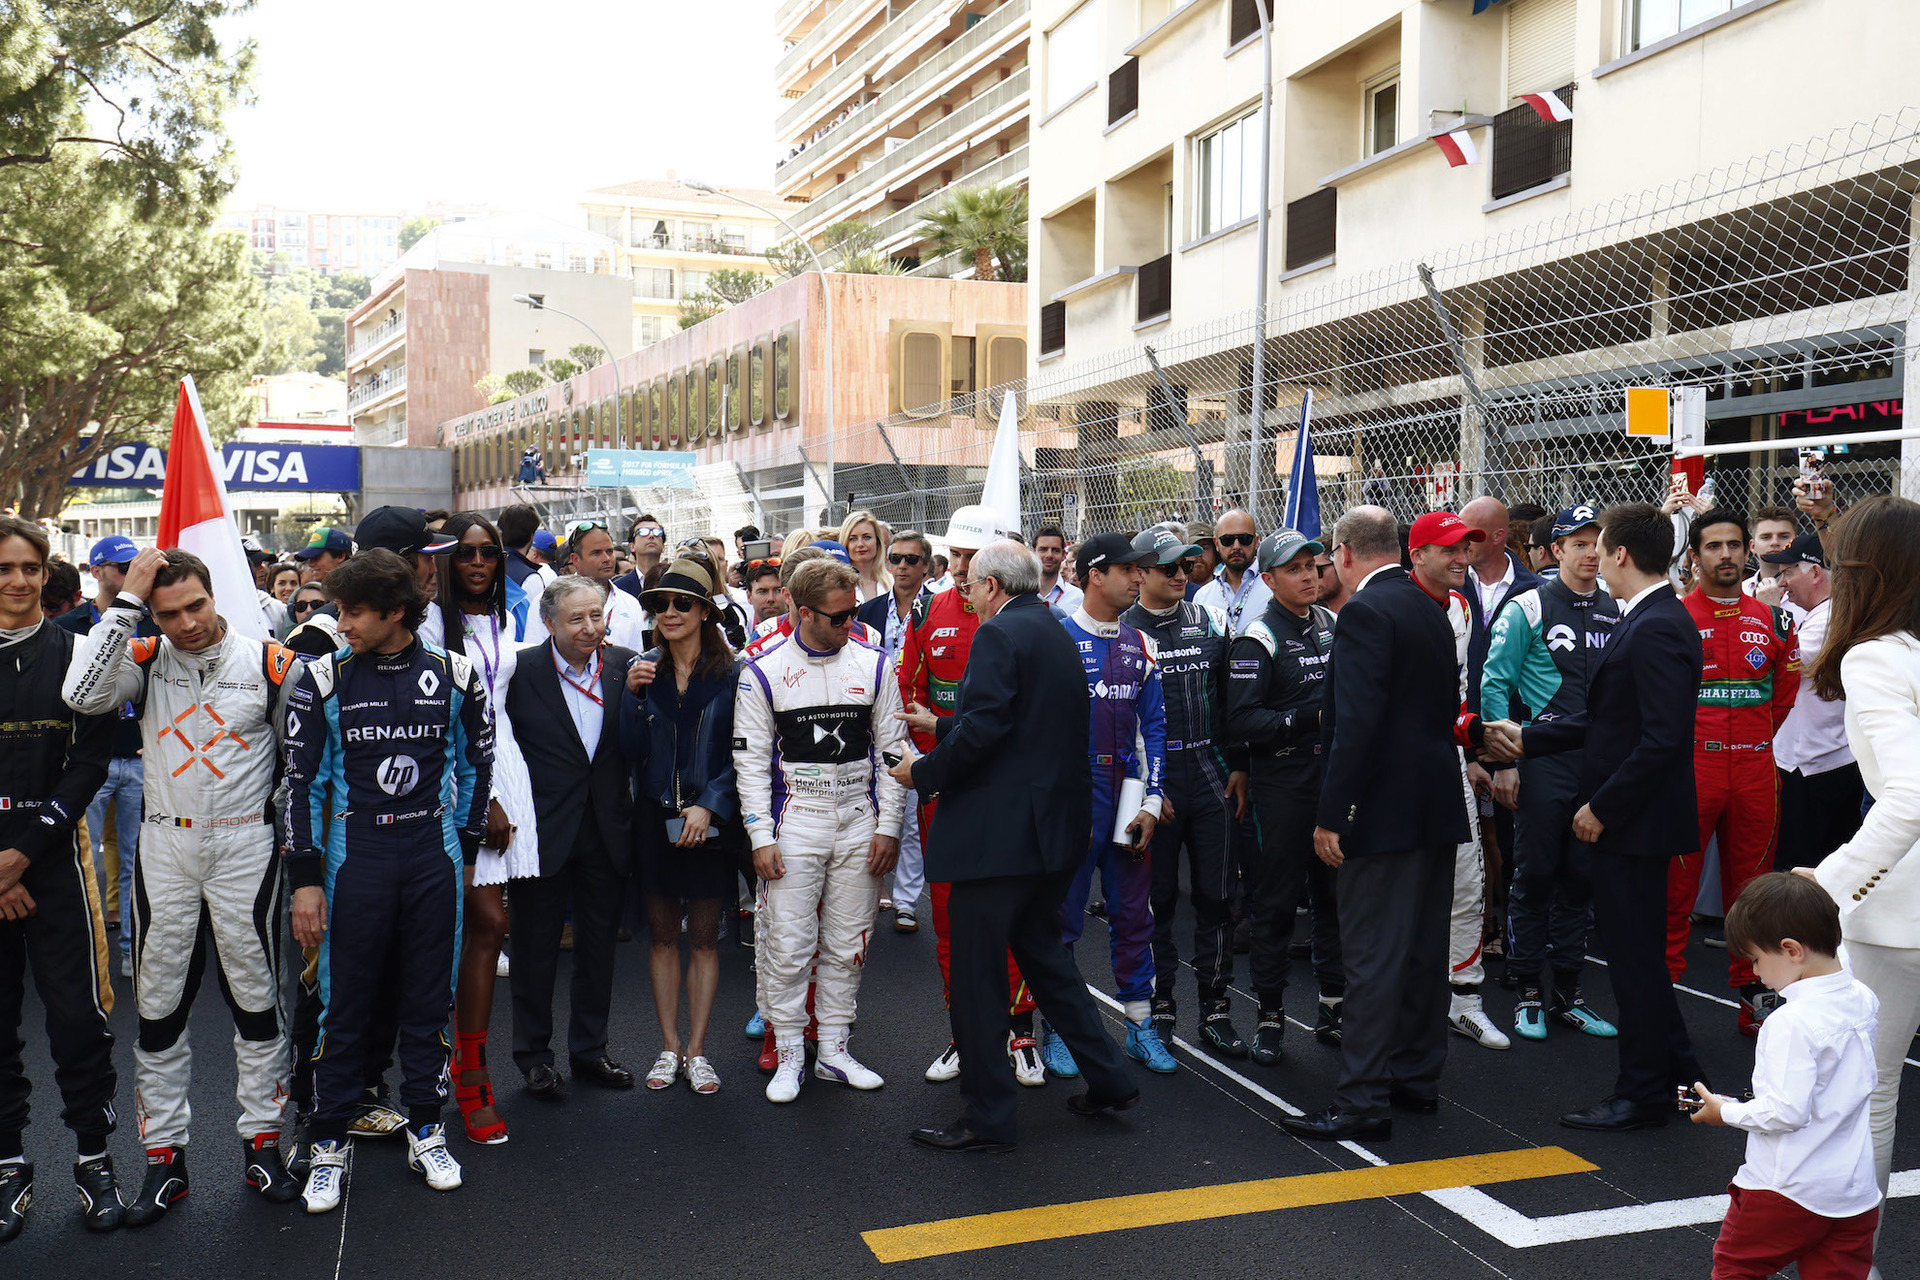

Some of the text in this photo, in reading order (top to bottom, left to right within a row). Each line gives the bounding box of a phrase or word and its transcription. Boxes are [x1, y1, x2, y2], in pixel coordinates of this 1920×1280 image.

[222, 450, 309, 484] VISA
[622, 468, 651, 476] MONACO
[70, 629, 117, 702] FARADAY FUTURE
[76, 632, 124, 706] DRAGON RACING
[377, 662, 411, 671] RENAULT
[1162, 660, 1210, 673] GUAR
[783, 667, 808, 689] Virgin
[1230, 671, 1258, 679] Panasonic
[342, 702, 368, 711] RICHARD
[346, 724, 445, 742] RENAULT
[383, 754, 414, 797] hp
[795, 778, 831, 787] Hewlett
[201, 813, 262, 829] JEROME
[396, 809, 428, 821] NICOLAS
